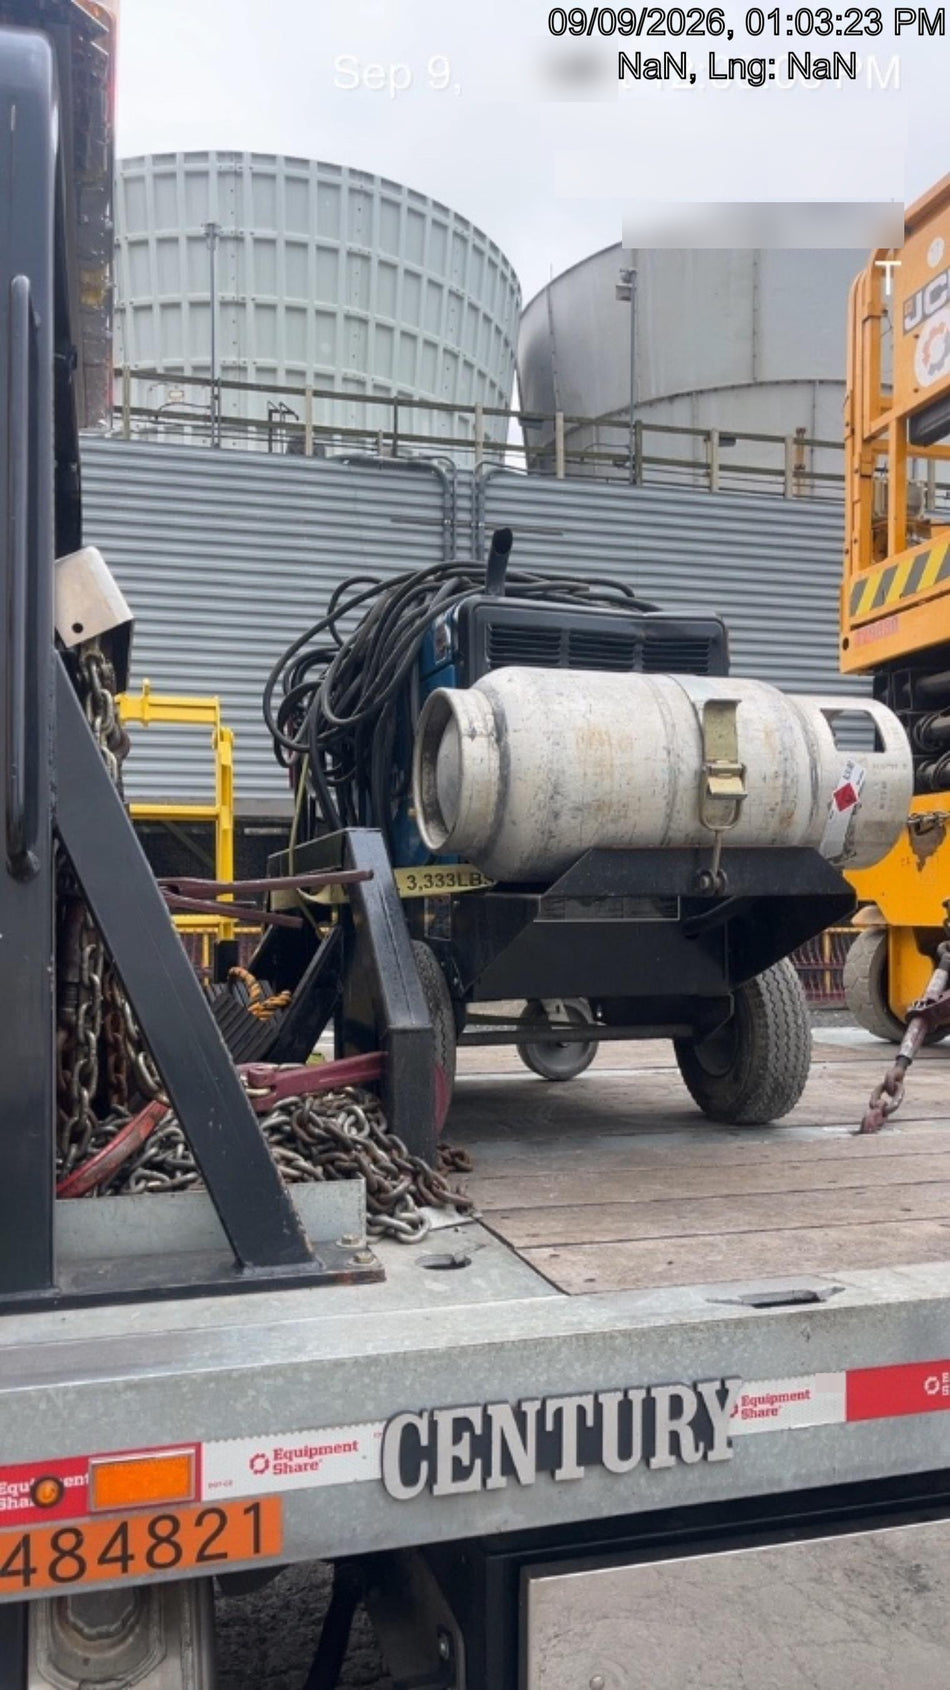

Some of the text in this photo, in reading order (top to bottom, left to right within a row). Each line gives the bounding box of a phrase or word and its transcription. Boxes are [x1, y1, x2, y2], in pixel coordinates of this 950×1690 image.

[904, 268, 950, 331] JC
[741, 1389, 811, 1407] Equipment
[741, 1407, 779, 1420] Share
[380, 1376, 742, 1501] CENTURY
[272, 1439, 360, 1462] Equipment
[272, 1460, 320, 1475] Share
[0, 1501, 263, 1588] 484821
